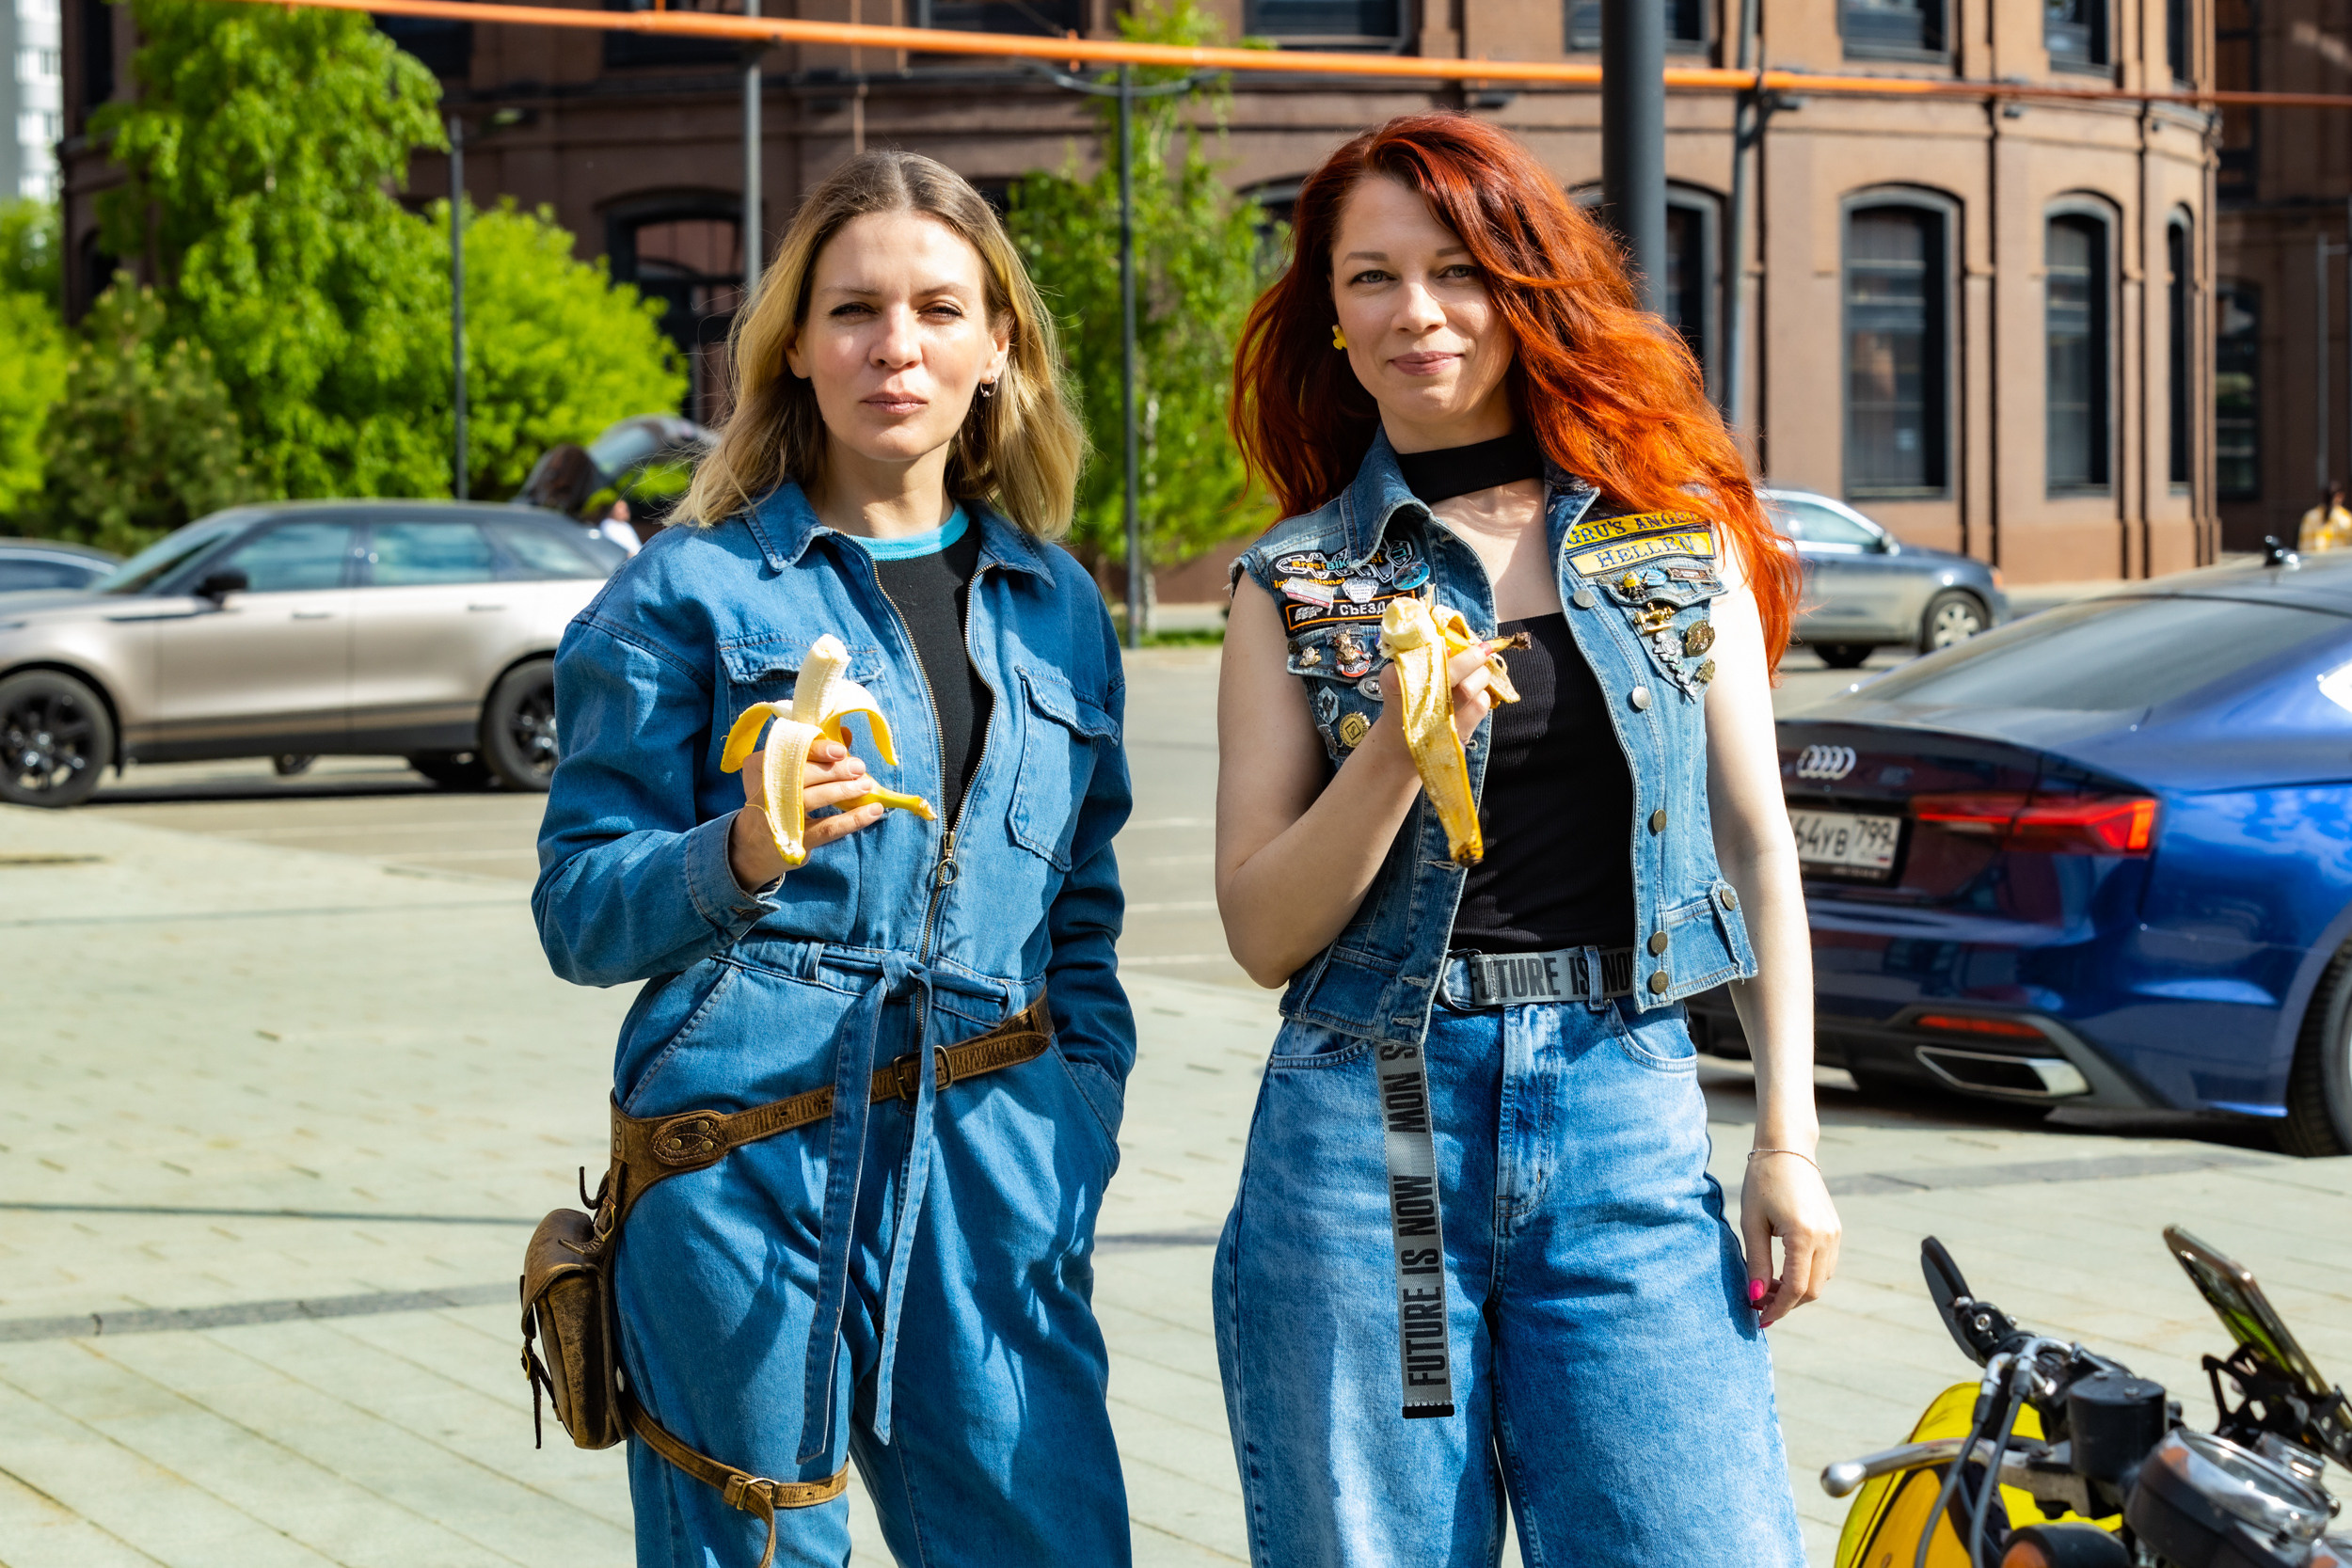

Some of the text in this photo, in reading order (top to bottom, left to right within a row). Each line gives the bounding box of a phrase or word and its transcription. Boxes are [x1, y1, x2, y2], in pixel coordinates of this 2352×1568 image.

[1595, 535, 1696, 568] HELLEN
[1855, 819, 1891, 849] 799
[1568, 957, 1590, 995] IS
[1601, 951, 1633, 993] NO
[1383, 1072, 1427, 1132] NOW
[1393, 1175, 1446, 1386] FUTURE IS NOW
